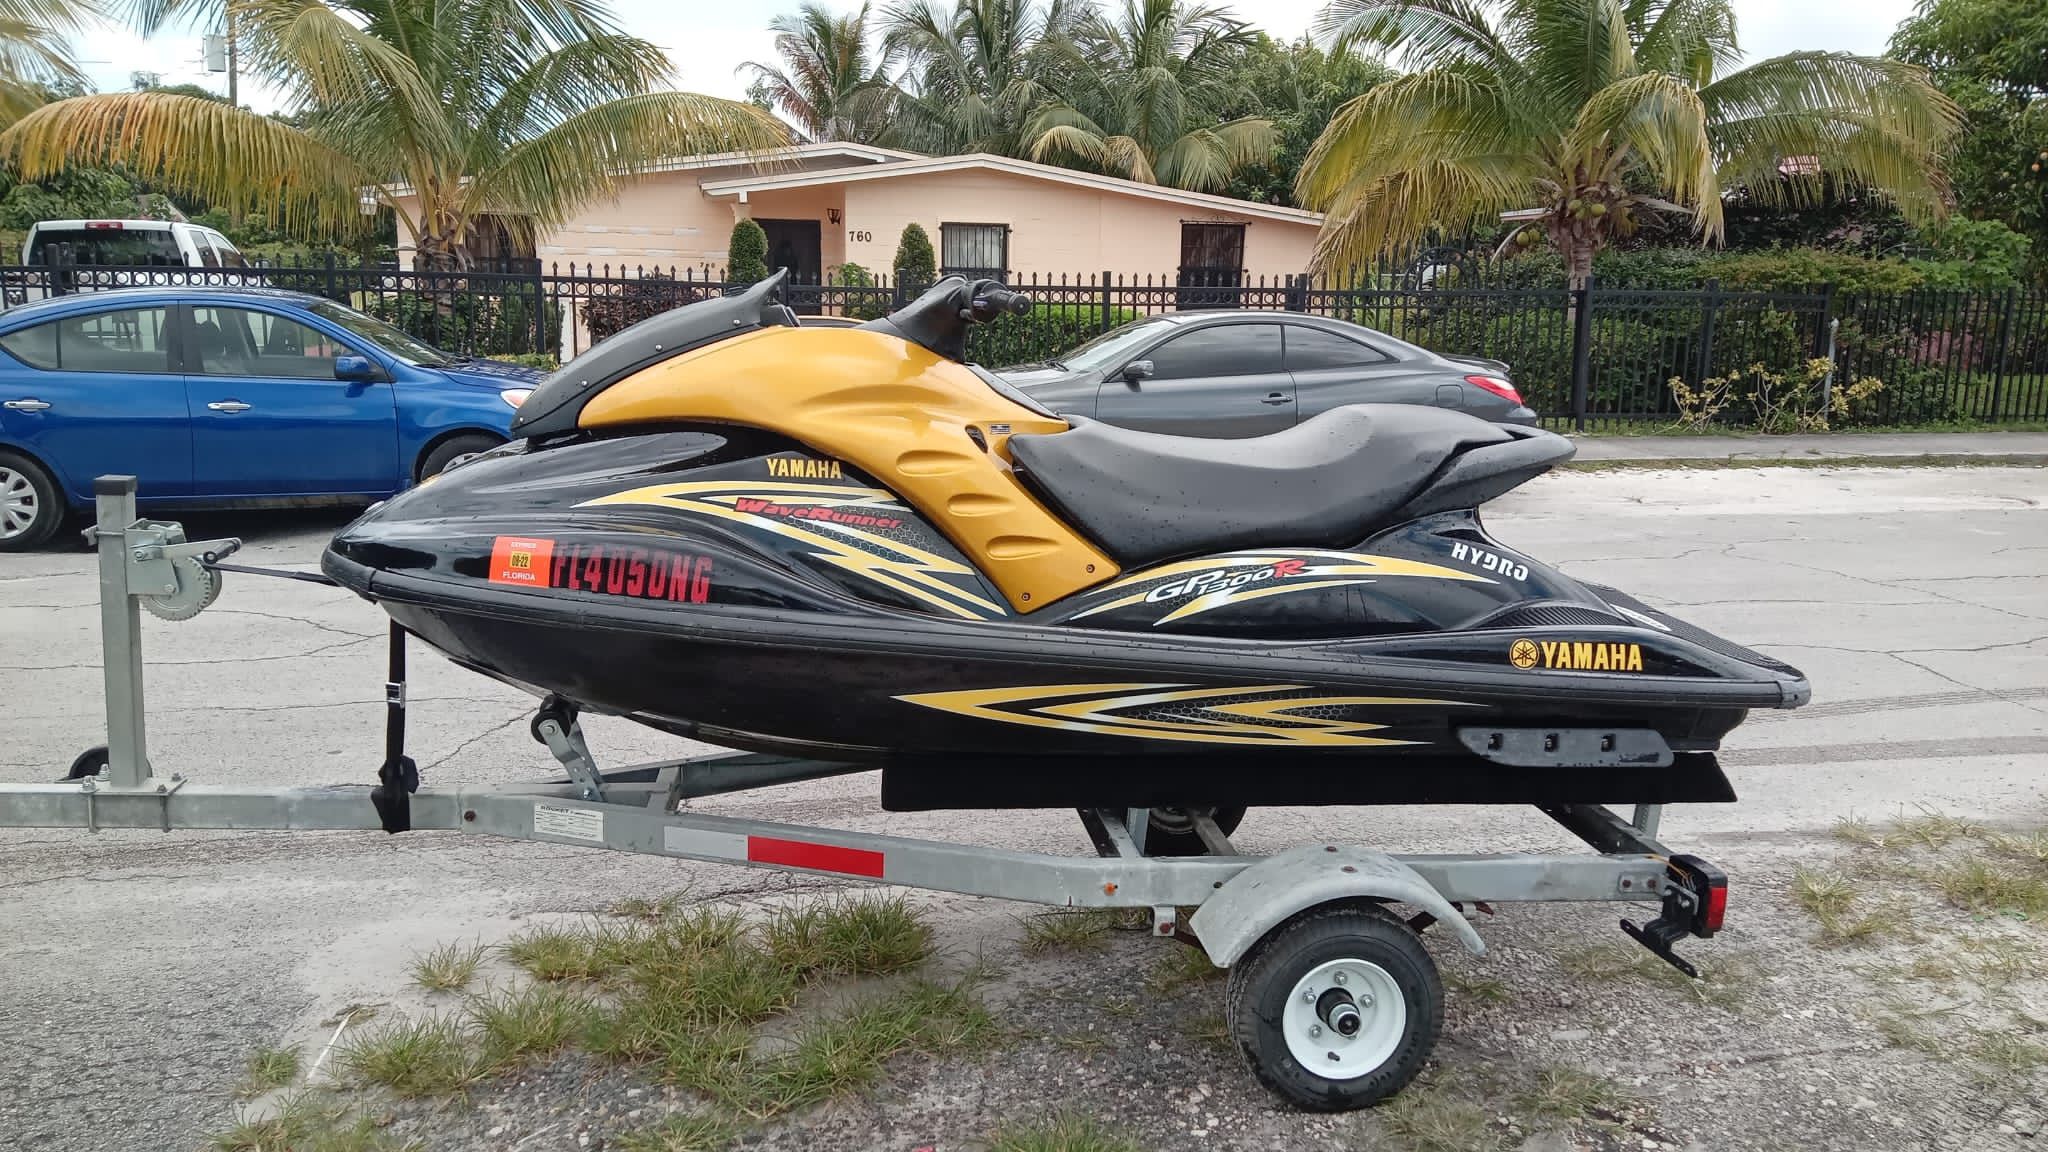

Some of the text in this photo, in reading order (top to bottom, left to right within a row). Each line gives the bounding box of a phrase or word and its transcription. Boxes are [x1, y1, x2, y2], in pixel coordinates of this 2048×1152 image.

[848, 230, 872, 242] 760
[766, 458, 842, 480] YAMAHA
[734, 497, 902, 528] WaveRunner
[1451, 542, 1529, 581] HYDRO
[502, 571, 536, 581] FLORIDA
[1540, 641, 1644, 671] YAMAHA
